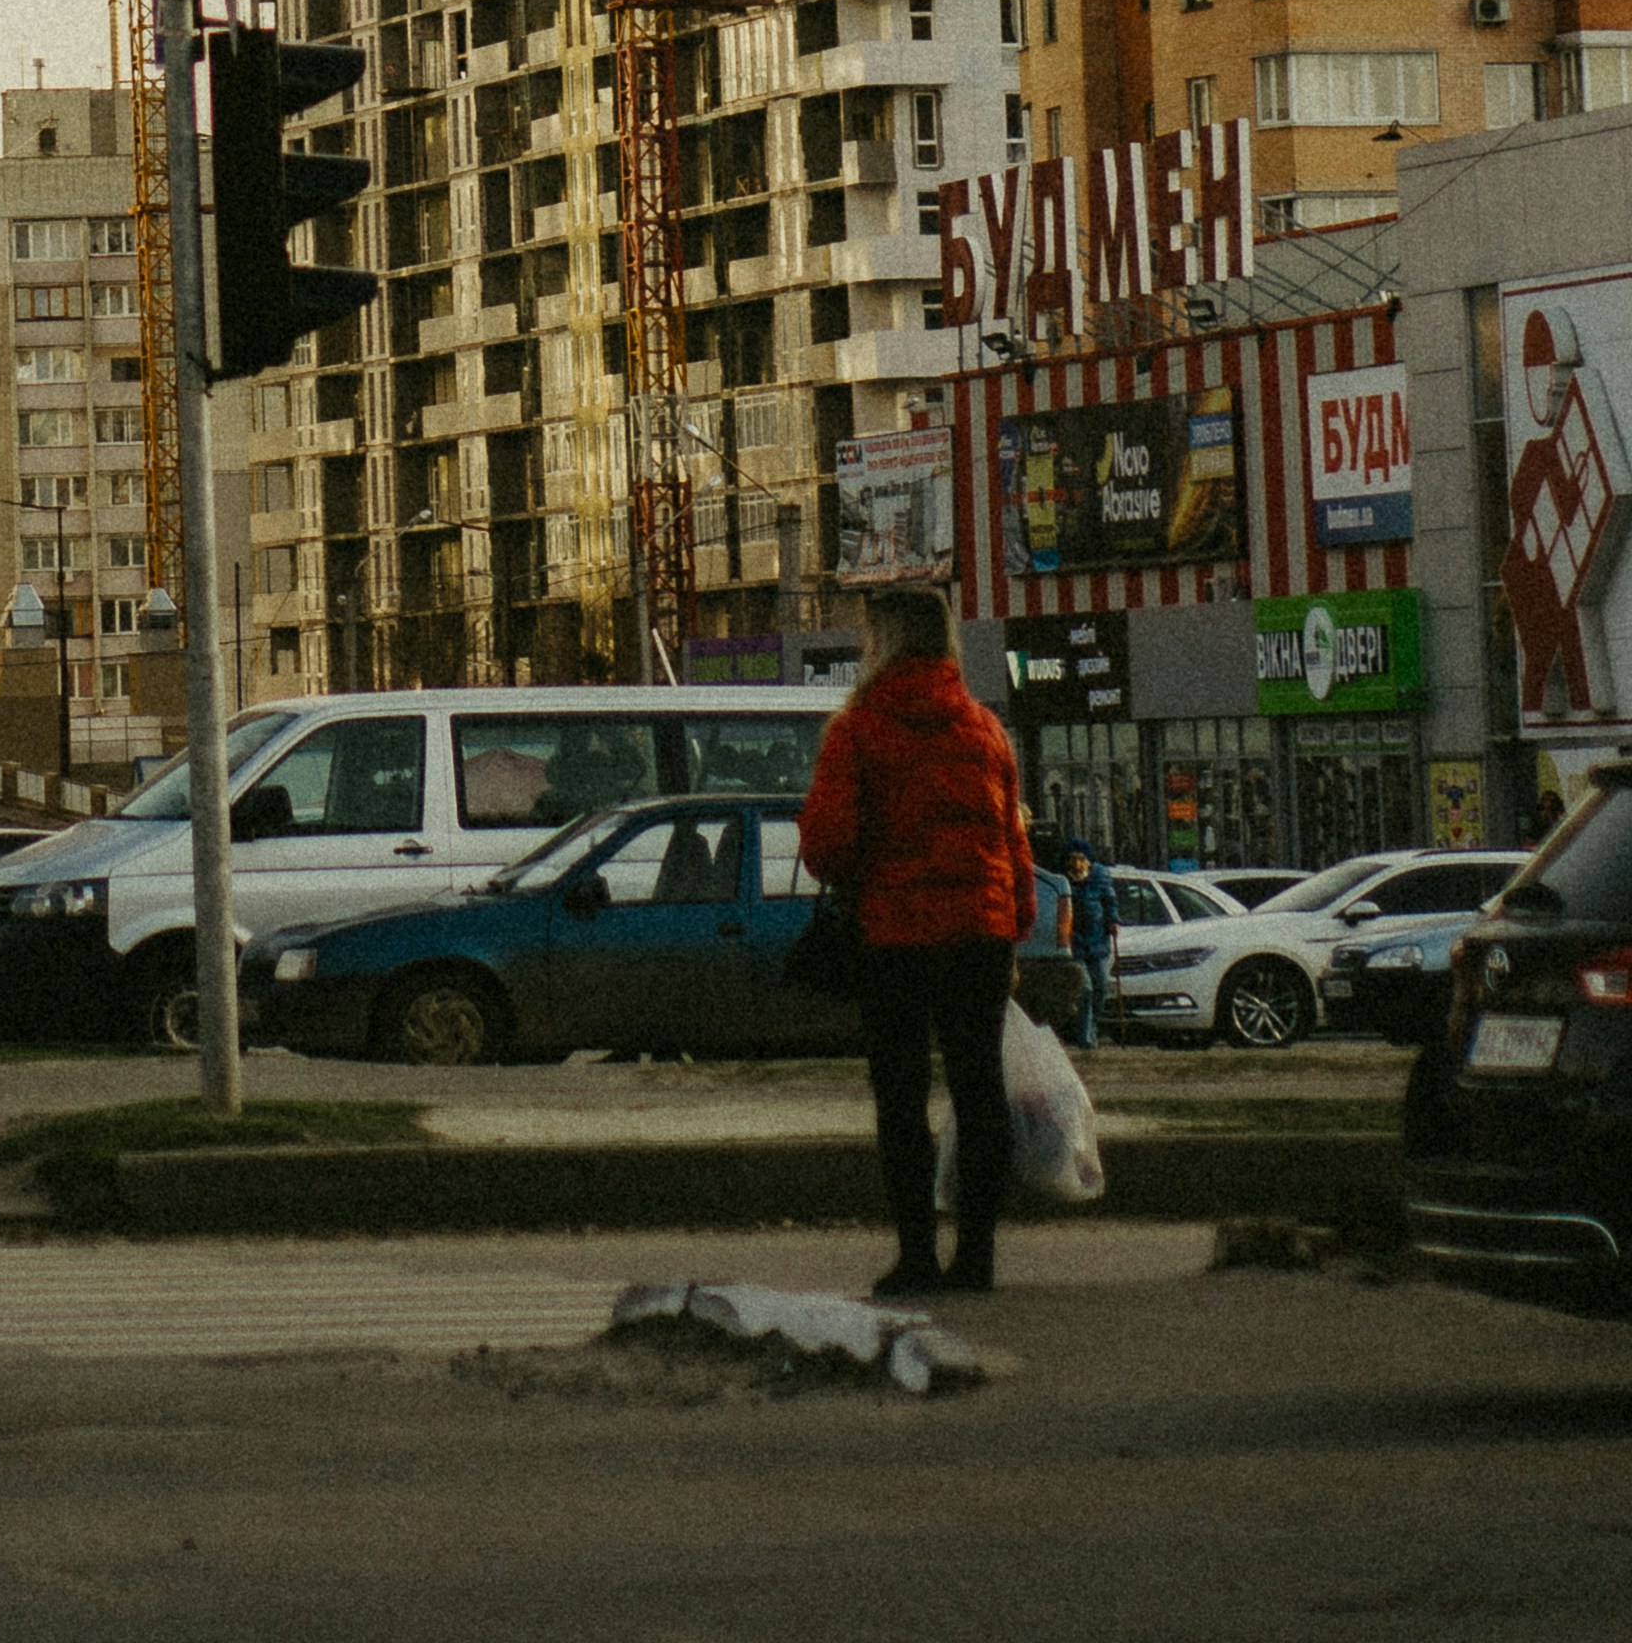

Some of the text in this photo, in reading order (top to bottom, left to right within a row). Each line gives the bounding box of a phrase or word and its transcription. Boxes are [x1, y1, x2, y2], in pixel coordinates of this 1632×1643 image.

[939, 117, 1254, 342] БУДМЕН
[1112, 431, 1150, 478] Novo
[1101, 480, 1162, 523] Abrasive
[1256, 626, 1383, 683] ВІКНА ДВЕРІ
